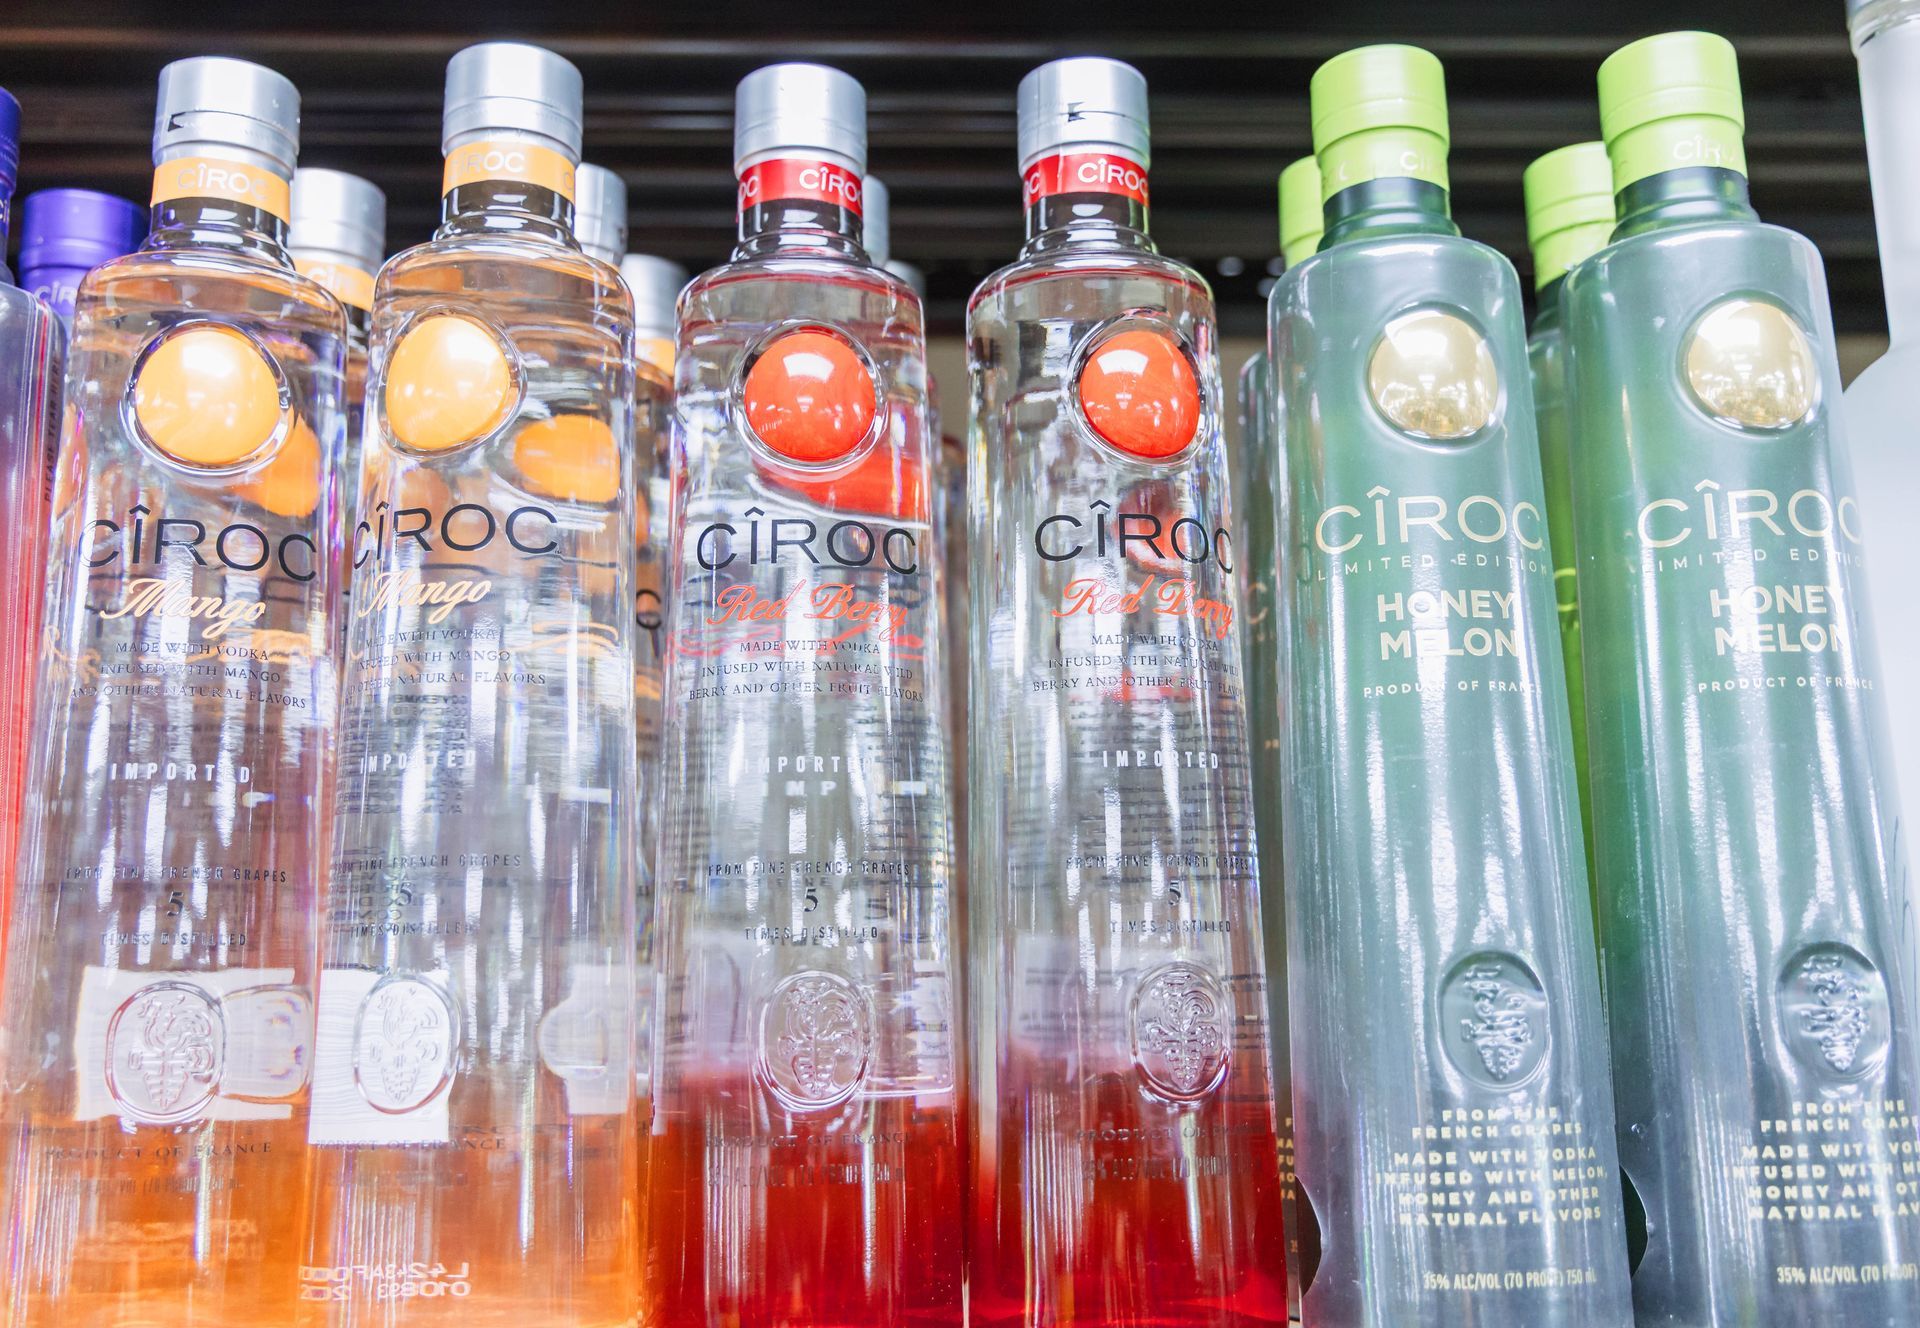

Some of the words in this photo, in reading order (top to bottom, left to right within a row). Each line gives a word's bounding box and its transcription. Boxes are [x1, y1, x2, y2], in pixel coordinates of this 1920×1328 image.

[177, 163, 267, 201] CÎROC
[1315, 485, 1544, 555] CÎROC
[1637, 479, 1863, 548] CÎROC
[78, 503, 317, 582] CÎROC
[353, 501, 559, 570] CÎROC
[696, 506, 917, 575] CÎROC
[1034, 499, 1234, 575] CÎROC
[1318, 554, 1434, 582] LIMITED
[1457, 553, 1547, 577] EDITION
[1789, 549, 1861, 567] EDITIO
[357, 571, 492, 626] Mango
[1051, 574, 1155, 618] Red
[1152, 578, 1233, 641] Berry
[1377, 590, 1515, 623] HONEY
[1709, 585, 1844, 618] HONEY
[99, 577, 267, 640] Mango
[706, 579, 807, 625] Red
[803, 583, 908, 642] Berry
[399, 631, 436, 641] WITH
[440, 628, 499, 641] VODKA
[1091, 634, 1131, 646] MADE
[1139, 634, 1177, 646] WITH
[1380, 627, 1519, 661] MELON
[1714, 623, 1845, 656] MELON
[115, 642, 160, 653] MADE
[165, 642, 217, 655] WITH
[216, 645, 269, 661] VODKA
[404, 651, 442, 663] WITH
[449, 650, 511, 661] MANGO
[740, 640, 781, 652] MADE
[786, 640, 828, 651] WITH
[832, 641, 880, 655] VODKA
[100, 664, 166, 674] INFUSED
[174, 664, 217, 676] WITH
[224, 668, 281, 682] MANGO
[702, 662, 759, 677] INFUSED
[764, 661, 805, 673] WITH
[811, 662, 879, 674] NATURAL
[1048, 655, 1112, 669] INFUSED
[1117, 655, 1158, 666] WITH
[1163, 656, 1219, 672] NATURAL
[398, 671, 466, 685] NATURAL
[474, 671, 547, 685] FLAVORS
[1032, 677, 1079, 692] BERRY
[1085, 676, 1119, 688] AND
[1126, 676, 1173, 687] OTHER
[1698, 677, 1787, 693] PRODUCT
[1796, 676, 1818, 687] OF
[71, 687, 98, 698] AND
[103, 686, 159, 696] OTHER
[163, 686, 243, 700] NATURAL
[249, 690, 306, 709] FLAVORS
[689, 684, 729, 700] BERRY
[732, 682, 763, 695] AND
[769, 682, 821, 694] OTHER
[829, 682, 871, 695] FRUIT
[877, 685, 924, 703] FLAVORS
[1363, 682, 1446, 699] PRODUT
[1457, 680, 1480, 692] OF
[1488, 680, 1537, 694] FRANE
[360, 749, 477, 774] IMPOTED
[1103, 750, 1219, 769] IMPORTED
[110, 762, 250, 783] IMPORTD
[459, 853, 521, 868] GRAPES
[708, 863, 744, 876] FROM
[753, 861, 786, 874] FINE
[795, 861, 853, 875] FRENCH
[861, 862, 910, 876] GRAPES
[233, 868, 287, 883] GRAPES
[803, 887, 819, 912] 5
[1169, 880, 1182, 906] 5
[166, 891, 184, 916] 5
[745, 926, 790, 940] TIMES
[1110, 920, 1158, 934] TIMES
[1167, 919, 1231, 933] DISTILLED
[1442, 1108, 1500, 1123] FROM
[1514, 1107, 1558, 1121] FINE
[1792, 1101, 1851, 1115] FROM
[1864, 1099, 1905, 1114] FINE
[1411, 1125, 1499, 1140] FRENCH
[1511, 1122, 1583, 1137] GRAPES
[1760, 1118, 1850, 1132] FRENCH
[155, 1145, 182, 1157] OF
[194, 1142, 272, 1158] FRANCE
[1394, 1151, 1457, 1166] MADE
[1469, 1149, 1528, 1164] WITH
[1540, 1147, 1597, 1162] VODKA
[1742, 1145, 1809, 1159] MADE
[1821, 1143, 1877, 1158] WITH
[1375, 1171, 1473, 1186] INFUSED
[1484, 1168, 1544, 1184] WITH
[1725, 1164, 1826, 1180] INFUSED
[1838, 1163, 1893, 1178] WITH
[1397, 1191, 1476, 1206] HONEY
[1487, 1190, 1534, 1205] AND
[1545, 1186, 1599, 1202] OTHER
[1749, 1185, 1829, 1200] HONEY
[1842, 1184, 1885, 1198] AND
[1399, 1212, 1507, 1227] NATURAL
[1750, 1205, 1862, 1220] NATURAL
[1423, 1270, 1450, 1290] 35%
[1453, 1272, 1501, 1291] ALC/VOL
[1504, 1271, 1524, 1291] (70
[1566, 1269, 1583, 1285] 750
[1776, 1266, 1806, 1285] 35%
[1809, 1265, 1858, 1283] ALC/VOL
[1861, 1264, 1878, 1282] (70
